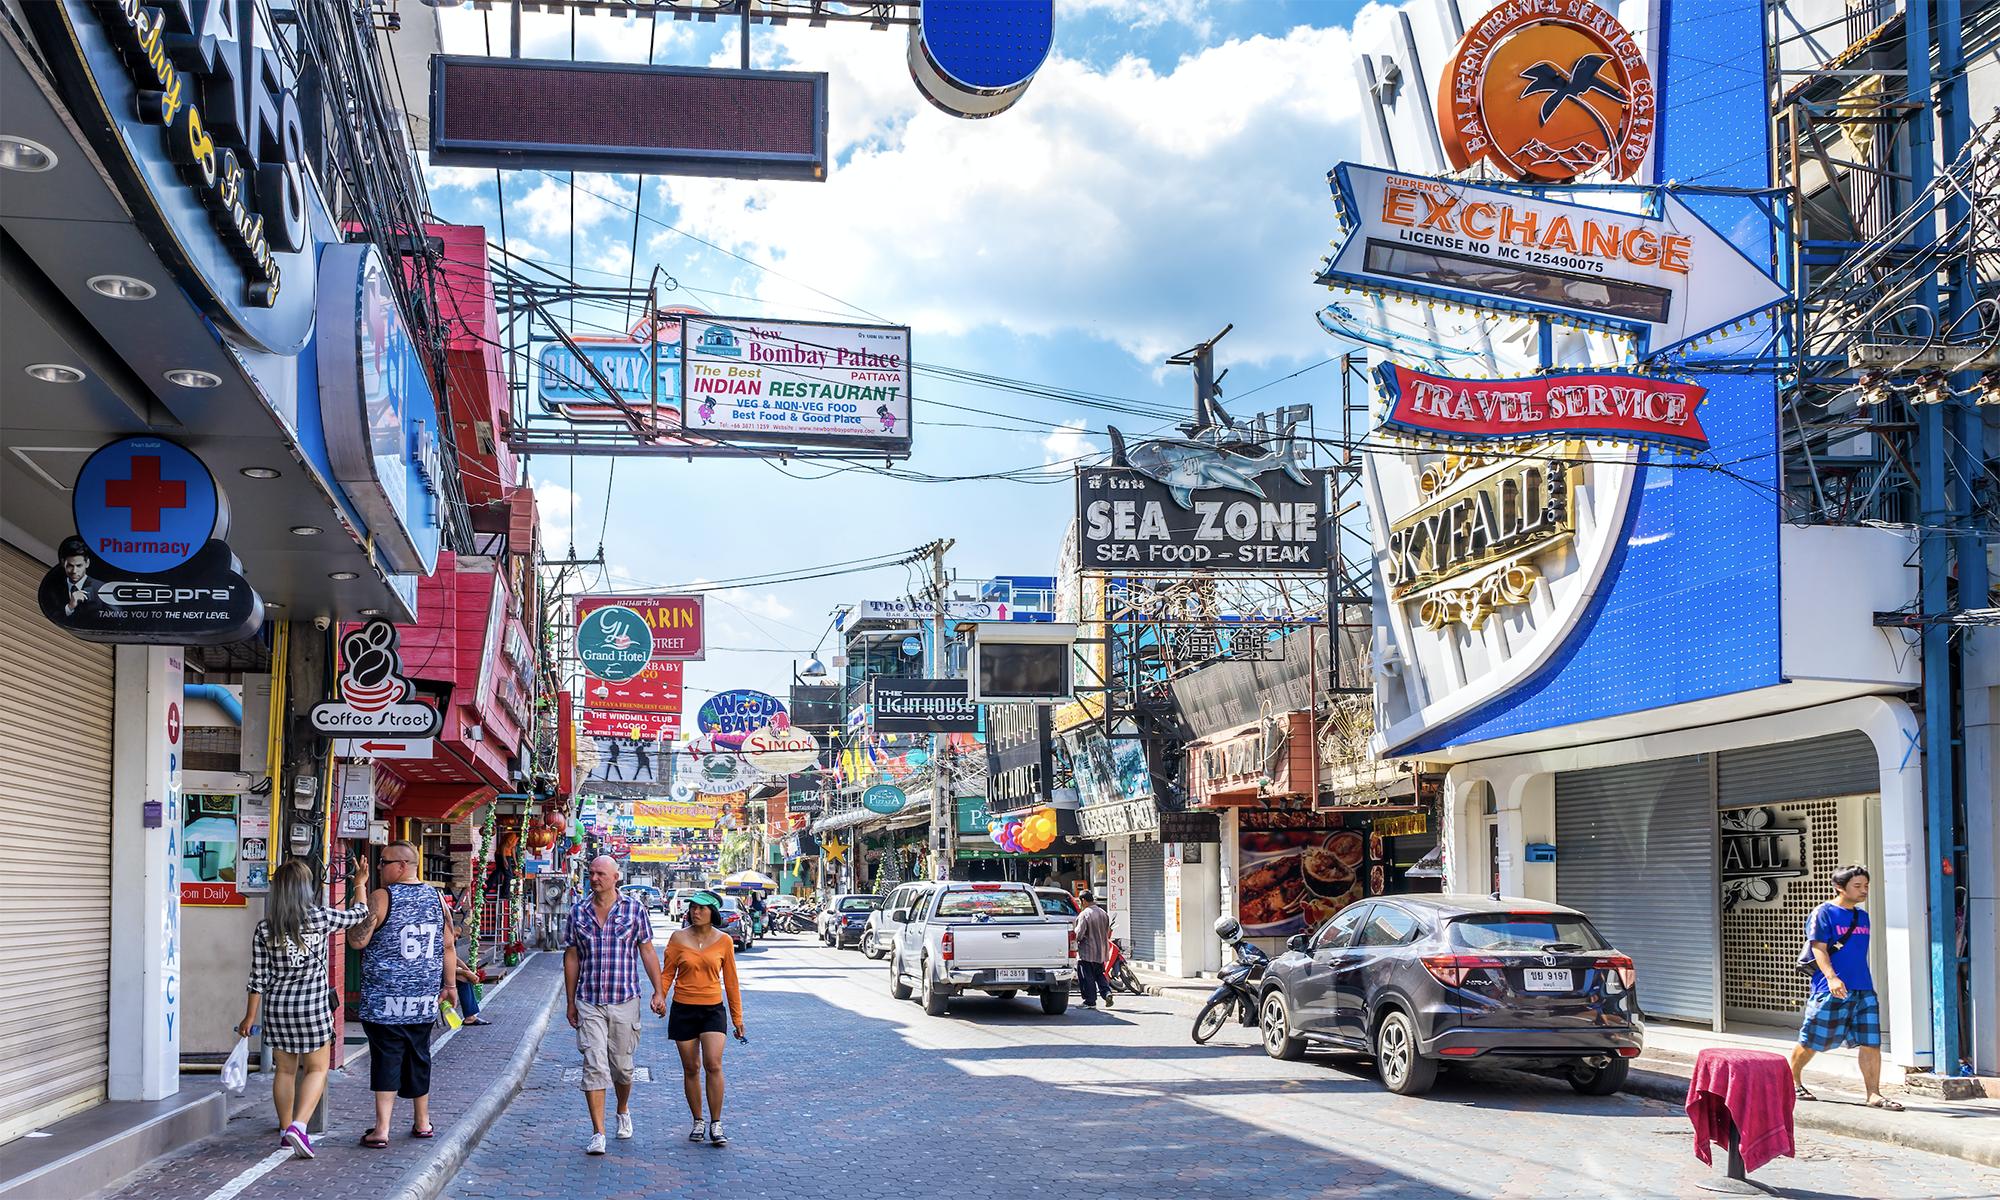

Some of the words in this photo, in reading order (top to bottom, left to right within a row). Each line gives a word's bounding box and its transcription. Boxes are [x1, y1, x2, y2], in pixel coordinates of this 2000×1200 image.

[1566, 1, 1645, 71] SERVICE
[1386, 176, 1448, 193] CURRENCY
[1382, 187, 1695, 273] EXCHANGE
[1399, 229, 1464, 250] LICENSE
[1468, 242, 1490, 254] NO
[1498, 247, 1521, 260] MC
[1525, 251, 1604, 273] 125490075
[750, 327, 781, 340] New
[750, 342, 828, 369] Bombay
[836, 347, 901, 369] Palace
[544, 354, 595, 390] BLUE
[602, 356, 643, 391] SKY
[694, 365, 721, 376] The
[728, 366, 761, 378] Best
[851, 372, 900, 382] PATTAYA
[693, 377, 761, 396] INDIAN
[769, 381, 900, 401] RESTAURANT
[737, 399, 758, 409] VEG
[762, 400, 770, 409] &
[775, 401, 824, 412] NON-VEG
[828, 403, 857, 413] FOOD
[1410, 380, 1544, 423] TRAVEL
[1546, 383, 1689, 426] SERVICE
[732, 410, 755, 420] Best
[759, 411, 786, 421] Food
[790, 412, 798, 421] &
[802, 413, 831, 423] Good
[834, 415, 861, 424] Place
[1086, 500, 1170, 541] SEA
[1193, 500, 1318, 543] ZONE
[1388, 466, 1546, 588] SKYFALL
[100, 538, 190, 557] Pharmacy
[1096, 544, 1141, 562] SEA
[1149, 544, 1212, 562] FOOD
[1237, 544, 1310, 562] STEAK
[99, 610, 128, 618] TAKING
[165, 611, 180, 619] THE
[182, 611, 203, 619] NEXT
[870, 601, 904, 612] The
[652, 638, 685, 649] STREET
[582, 650, 615, 661] Grand
[619, 651, 647, 662] Hotel
[641, 670, 658, 679] GO
[711, 693, 778, 716] WOOD
[878, 697, 975, 713] LIGHTHOUSE
[317, 709, 374, 726] Coffee
[378, 709, 430, 727] Street
[609, 713, 649, 722] WINDMILL
[651, 715, 673, 723] CLUB
[616, 722, 648, 730] AGOGO
[751, 737, 814, 756] SIMON
[167, 753, 177, 1042] PHARMACY
[204, 887, 230, 903] Daily
[400, 924, 437, 960] 67
[1547, 971, 1568, 981] 9197
[384, 996, 440, 1017] NETS
